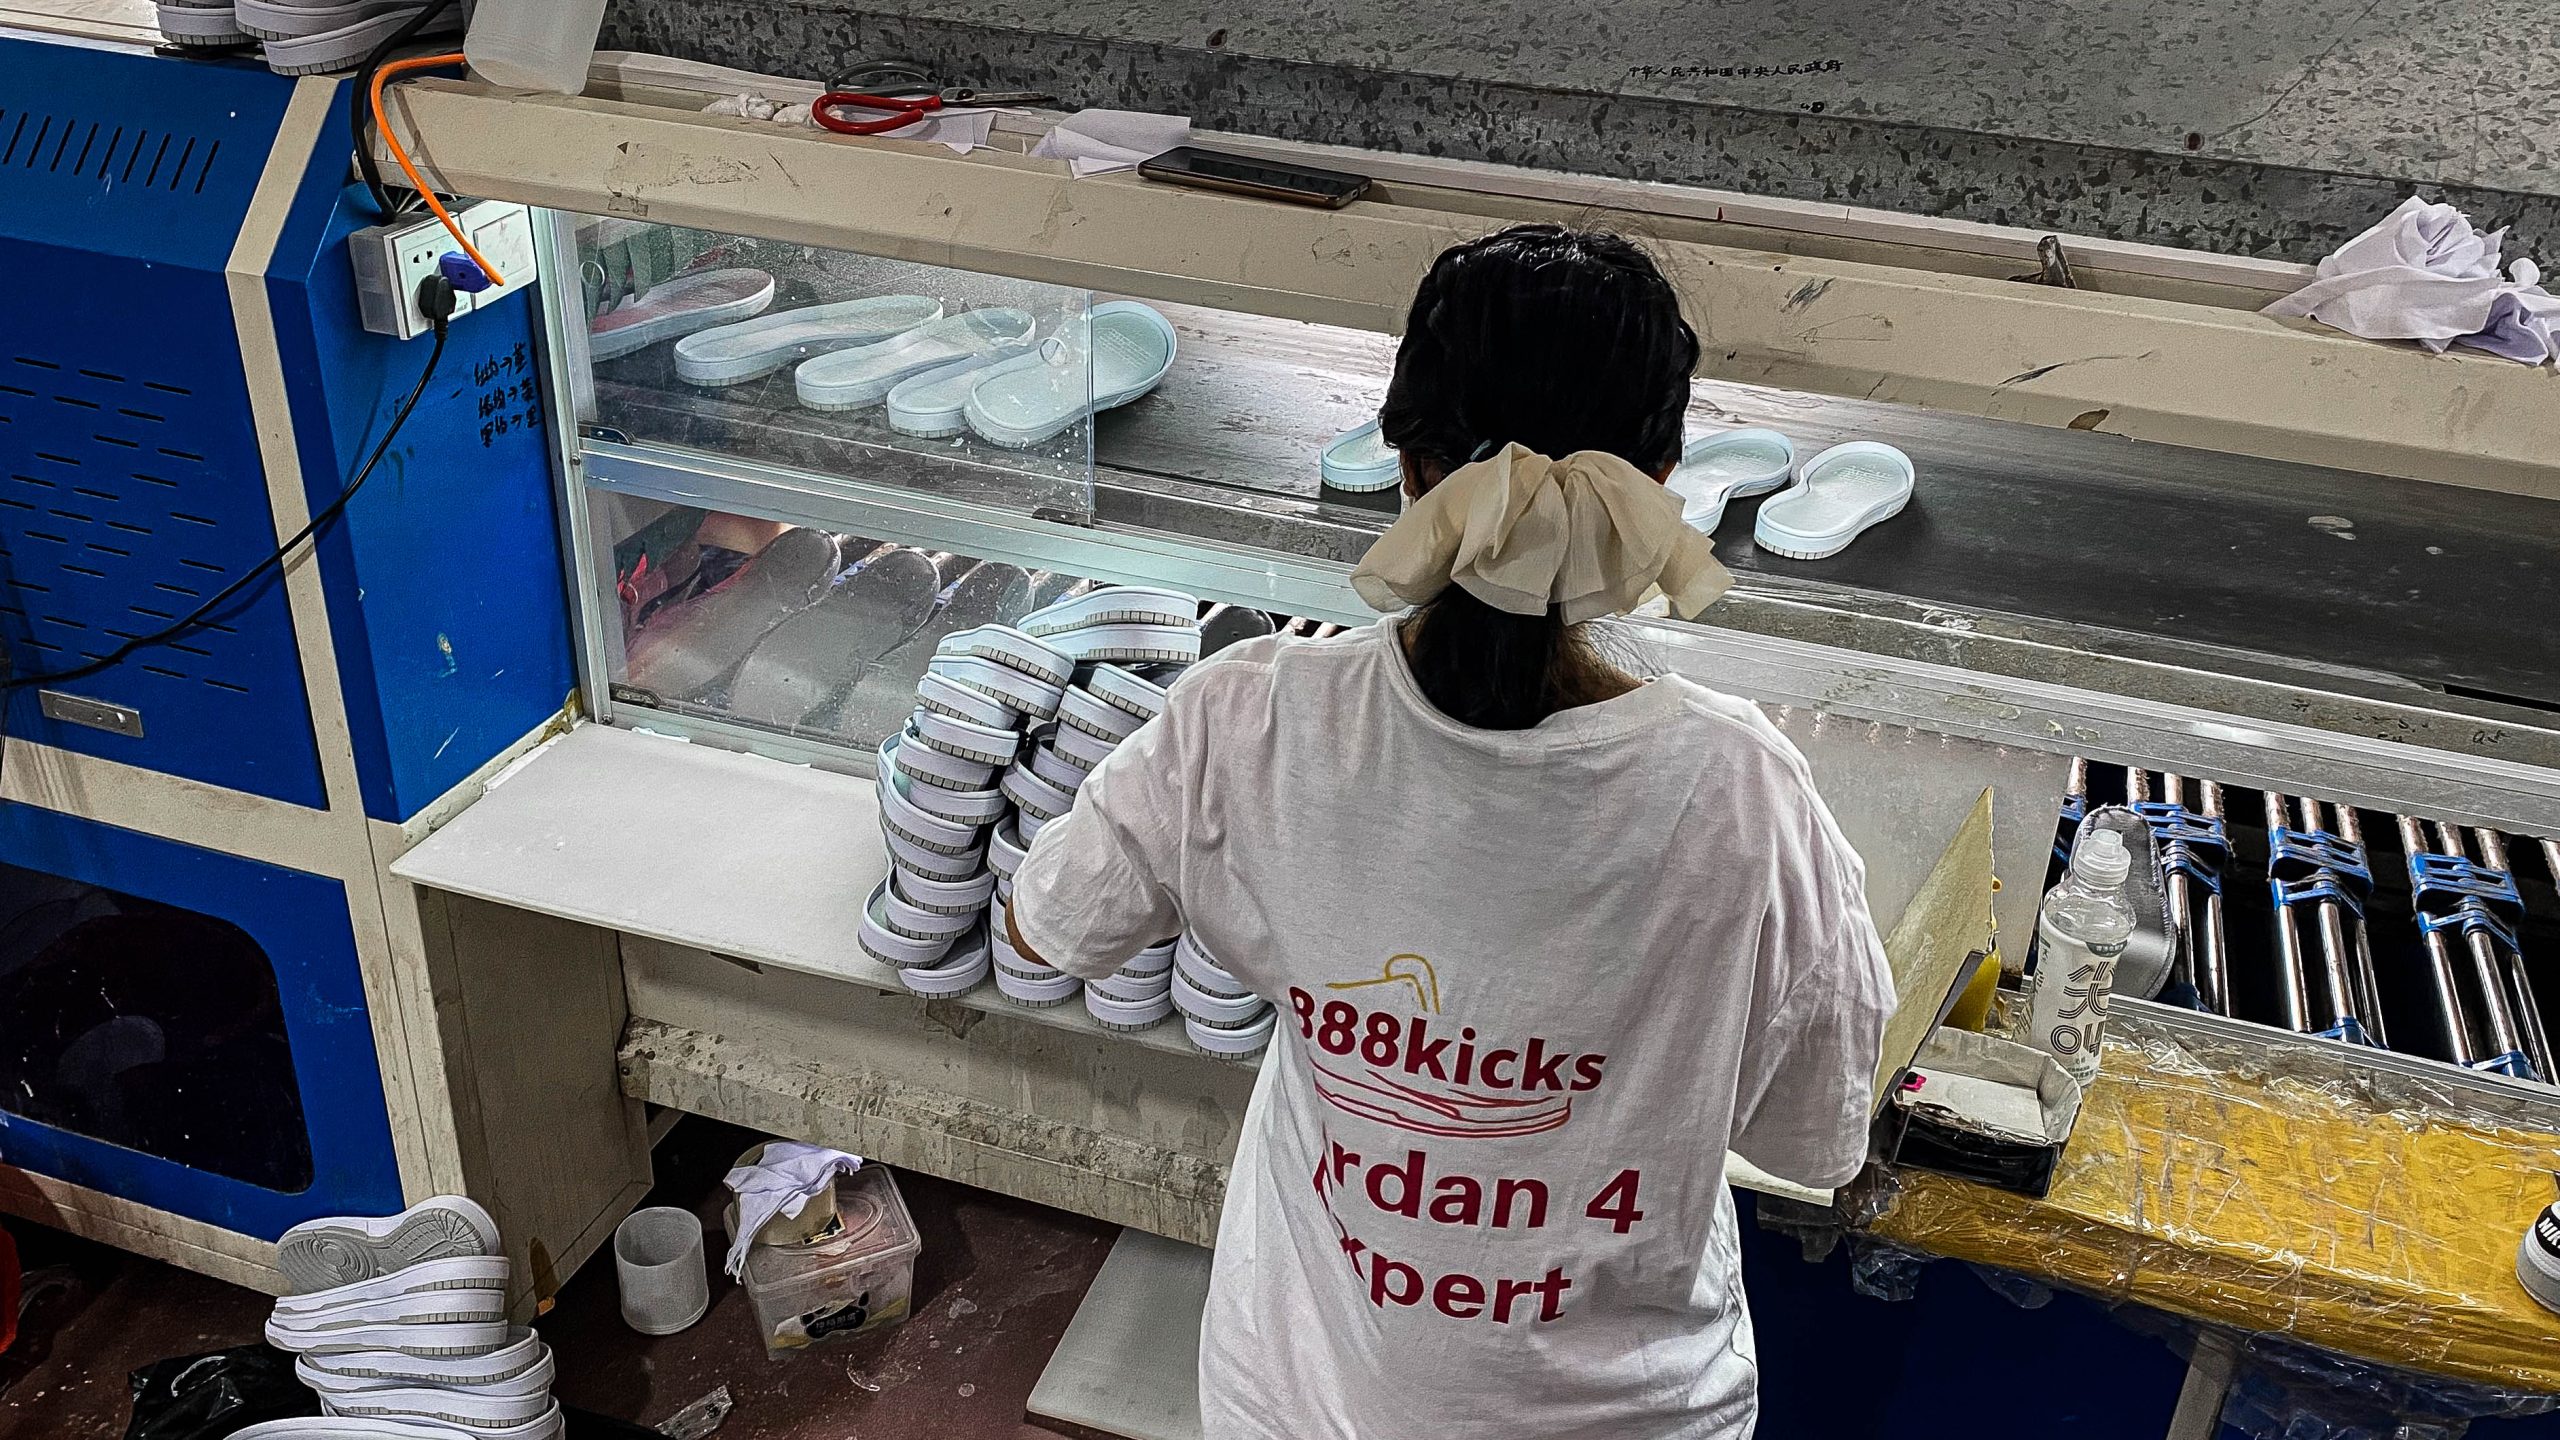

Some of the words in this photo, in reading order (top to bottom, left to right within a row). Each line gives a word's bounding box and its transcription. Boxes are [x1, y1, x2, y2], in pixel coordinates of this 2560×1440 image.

[1313, 1141, 1549, 1230] rdan
[1585, 1168, 1644, 1234] 4
[2538, 1216, 2560, 1249] NIK
[1338, 1237, 1572, 1324] xpert
